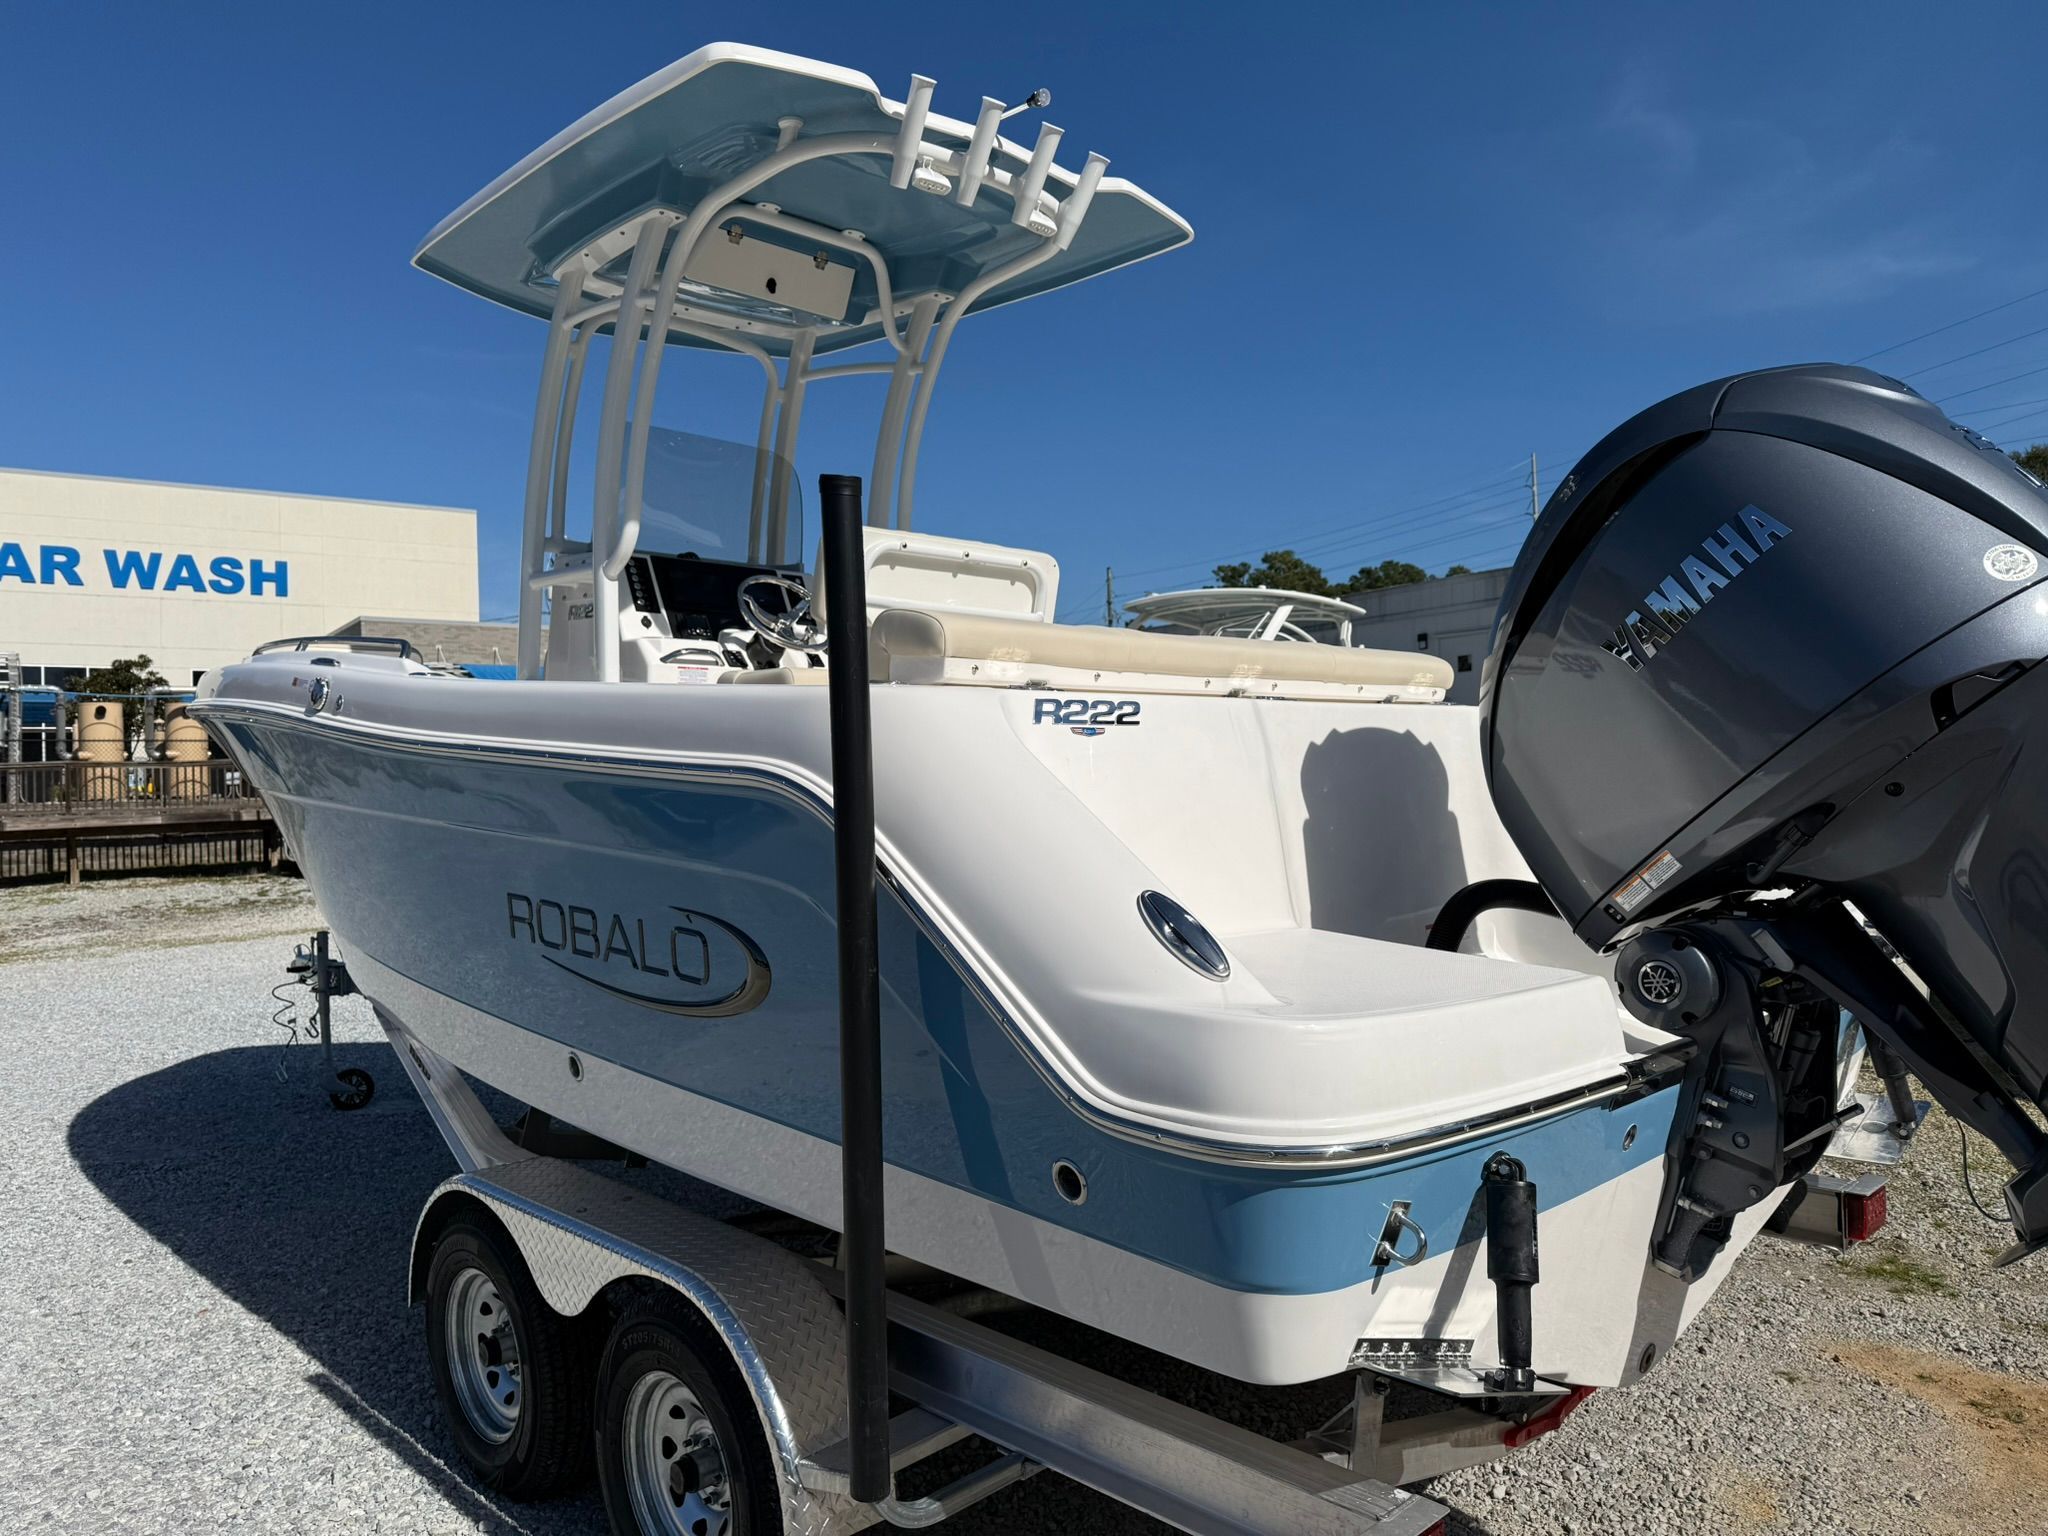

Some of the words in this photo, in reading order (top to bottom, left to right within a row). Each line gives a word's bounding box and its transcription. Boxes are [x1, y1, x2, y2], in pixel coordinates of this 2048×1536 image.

[103, 549, 288, 597] WASH
[1600, 504, 1793, 672] YAMAHA
[568, 604, 594, 620] R22
[1033, 698, 1141, 725] R222
[507, 892, 710, 986] ROBALO
